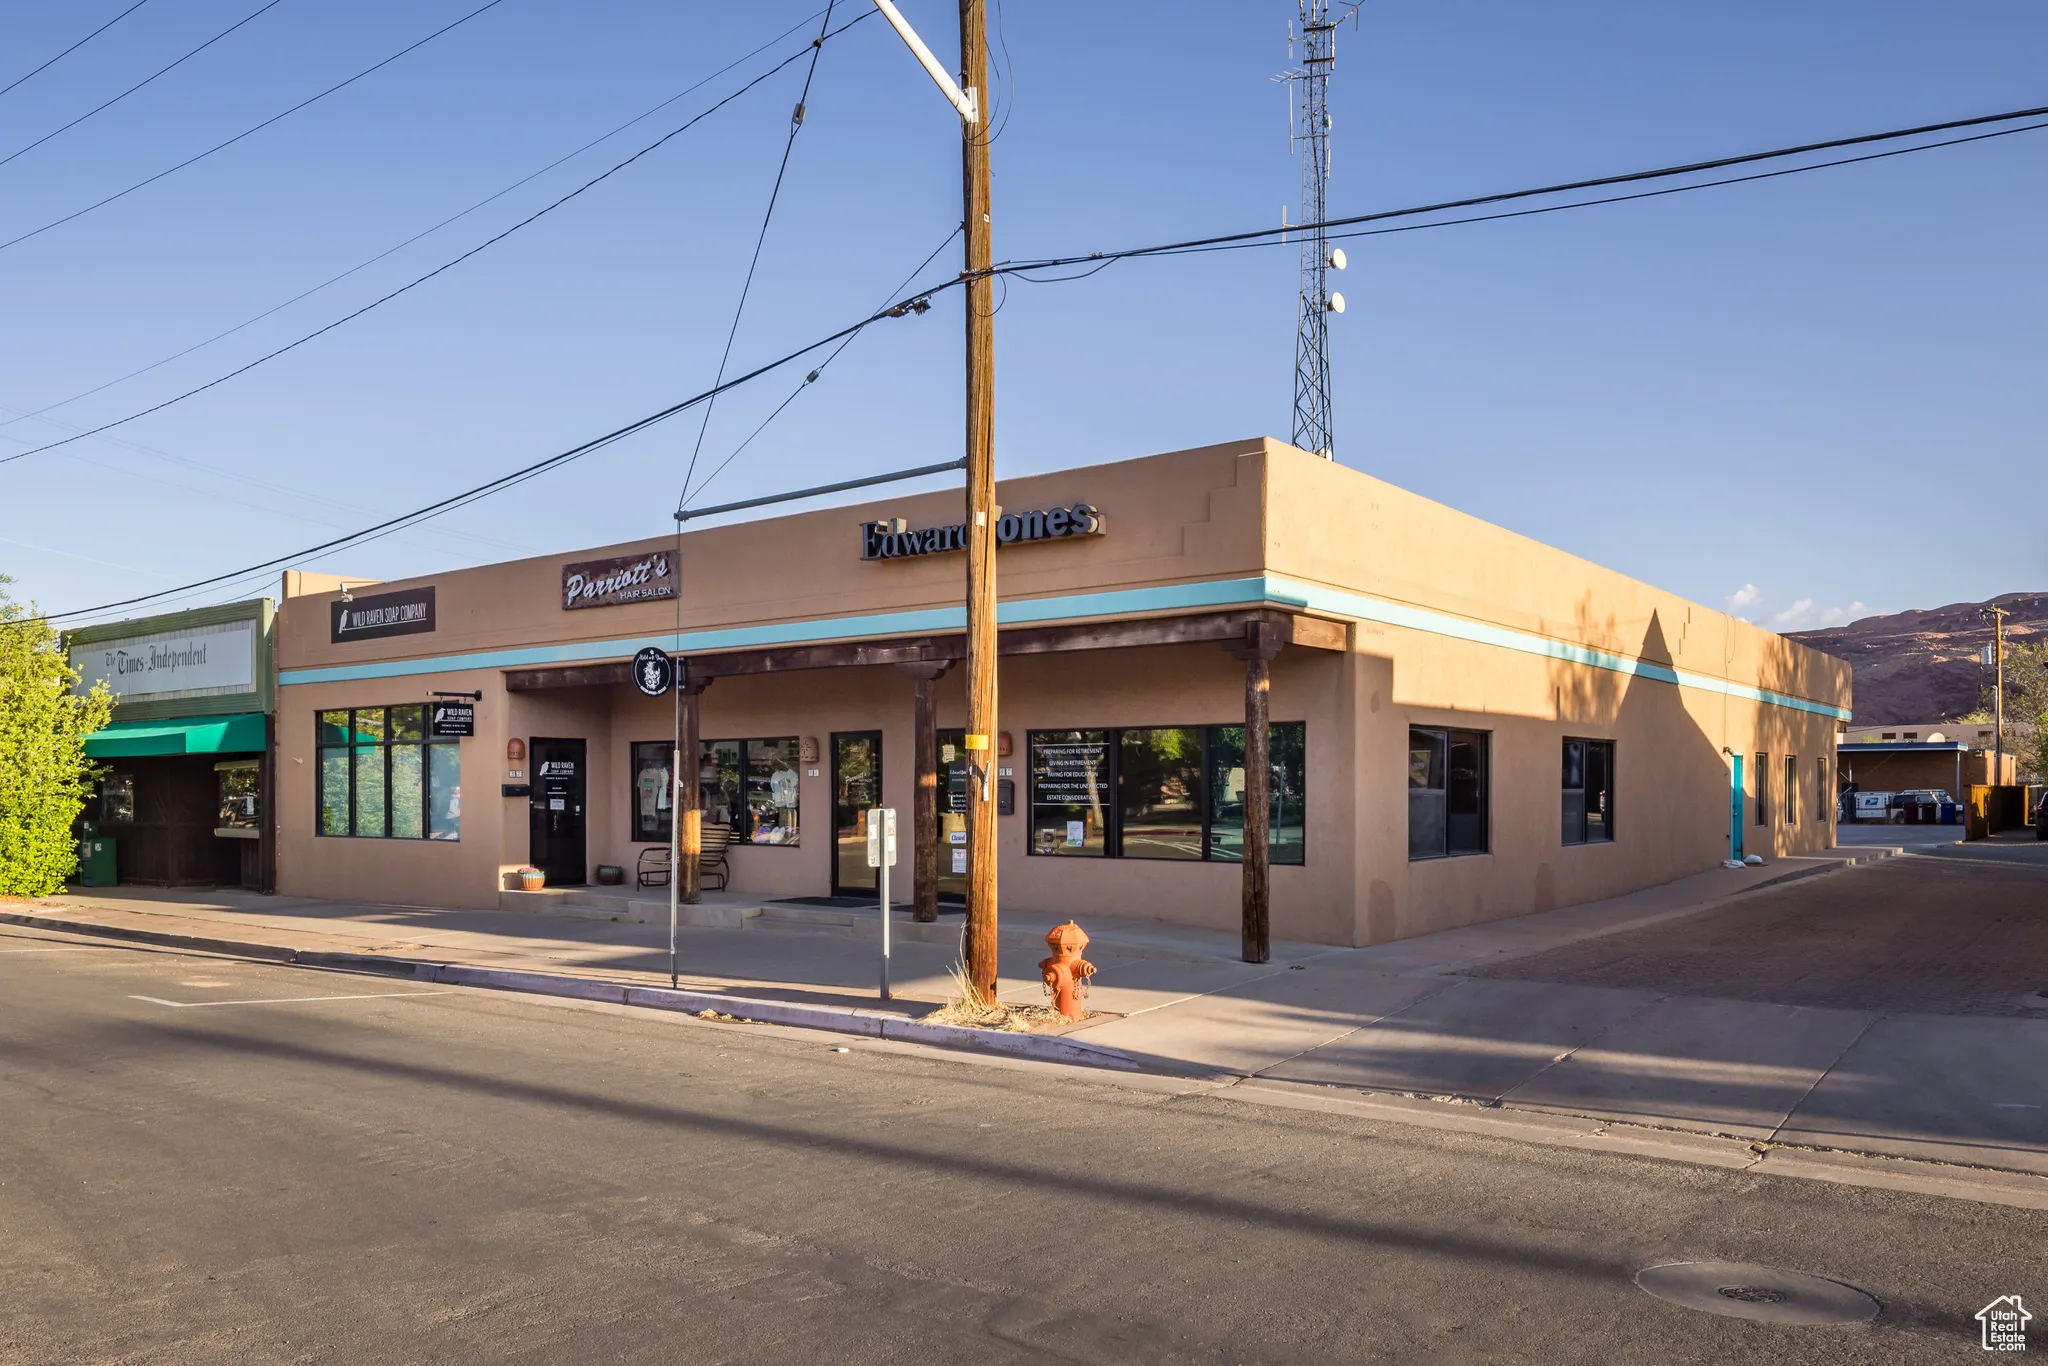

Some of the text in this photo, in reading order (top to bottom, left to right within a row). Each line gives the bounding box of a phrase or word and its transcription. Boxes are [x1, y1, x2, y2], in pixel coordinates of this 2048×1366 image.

[994, 504, 1099, 543] ones
[567, 554, 668, 606] Parriott's
[620, 586, 671, 600] HAIR SALON
[352, 602, 427, 627] WILD RAVEN SOAP COMPANY
[105, 652, 116, 667] The
[447, 708, 472, 717] WILD RAVEN
[551, 761, 560, 769] WILD
